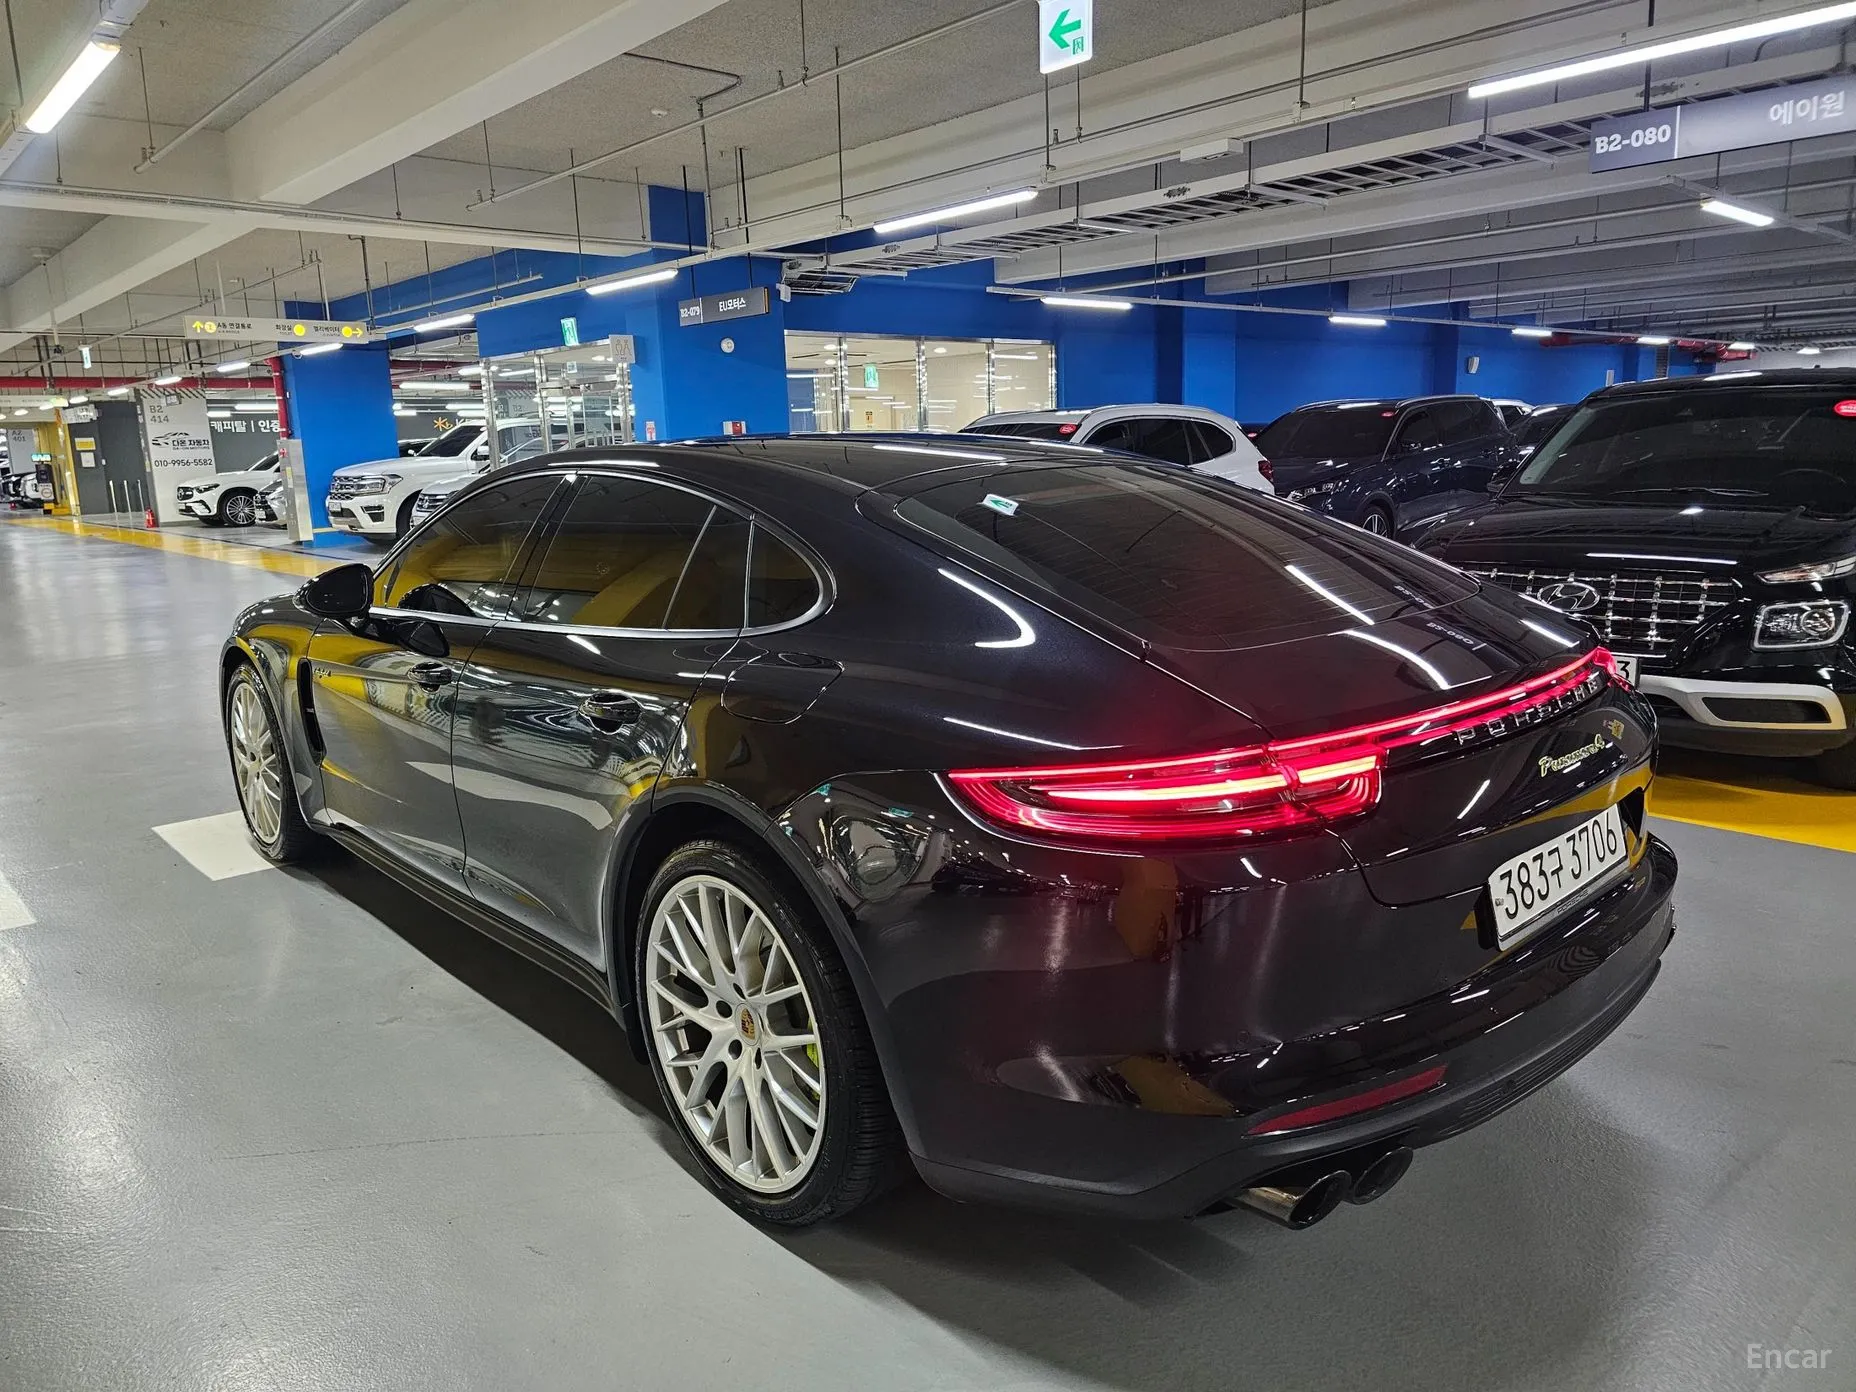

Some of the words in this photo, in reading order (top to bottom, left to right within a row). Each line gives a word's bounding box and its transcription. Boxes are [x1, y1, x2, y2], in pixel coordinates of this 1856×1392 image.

[1768, 90, 1846, 126] 에이원
[1594, 124, 1672, 154] B2-080
[149, 404, 164, 414] B2
[150, 415, 170, 424] 414
[210, 420, 247, 433] 캐피탈
[188, 438, 210, 447] 자동차
[154, 458, 213, 468] 010-9956-5582
[1456, 678, 1600, 746] PORSCHE
[1565, 811, 1618, 880] 3706
